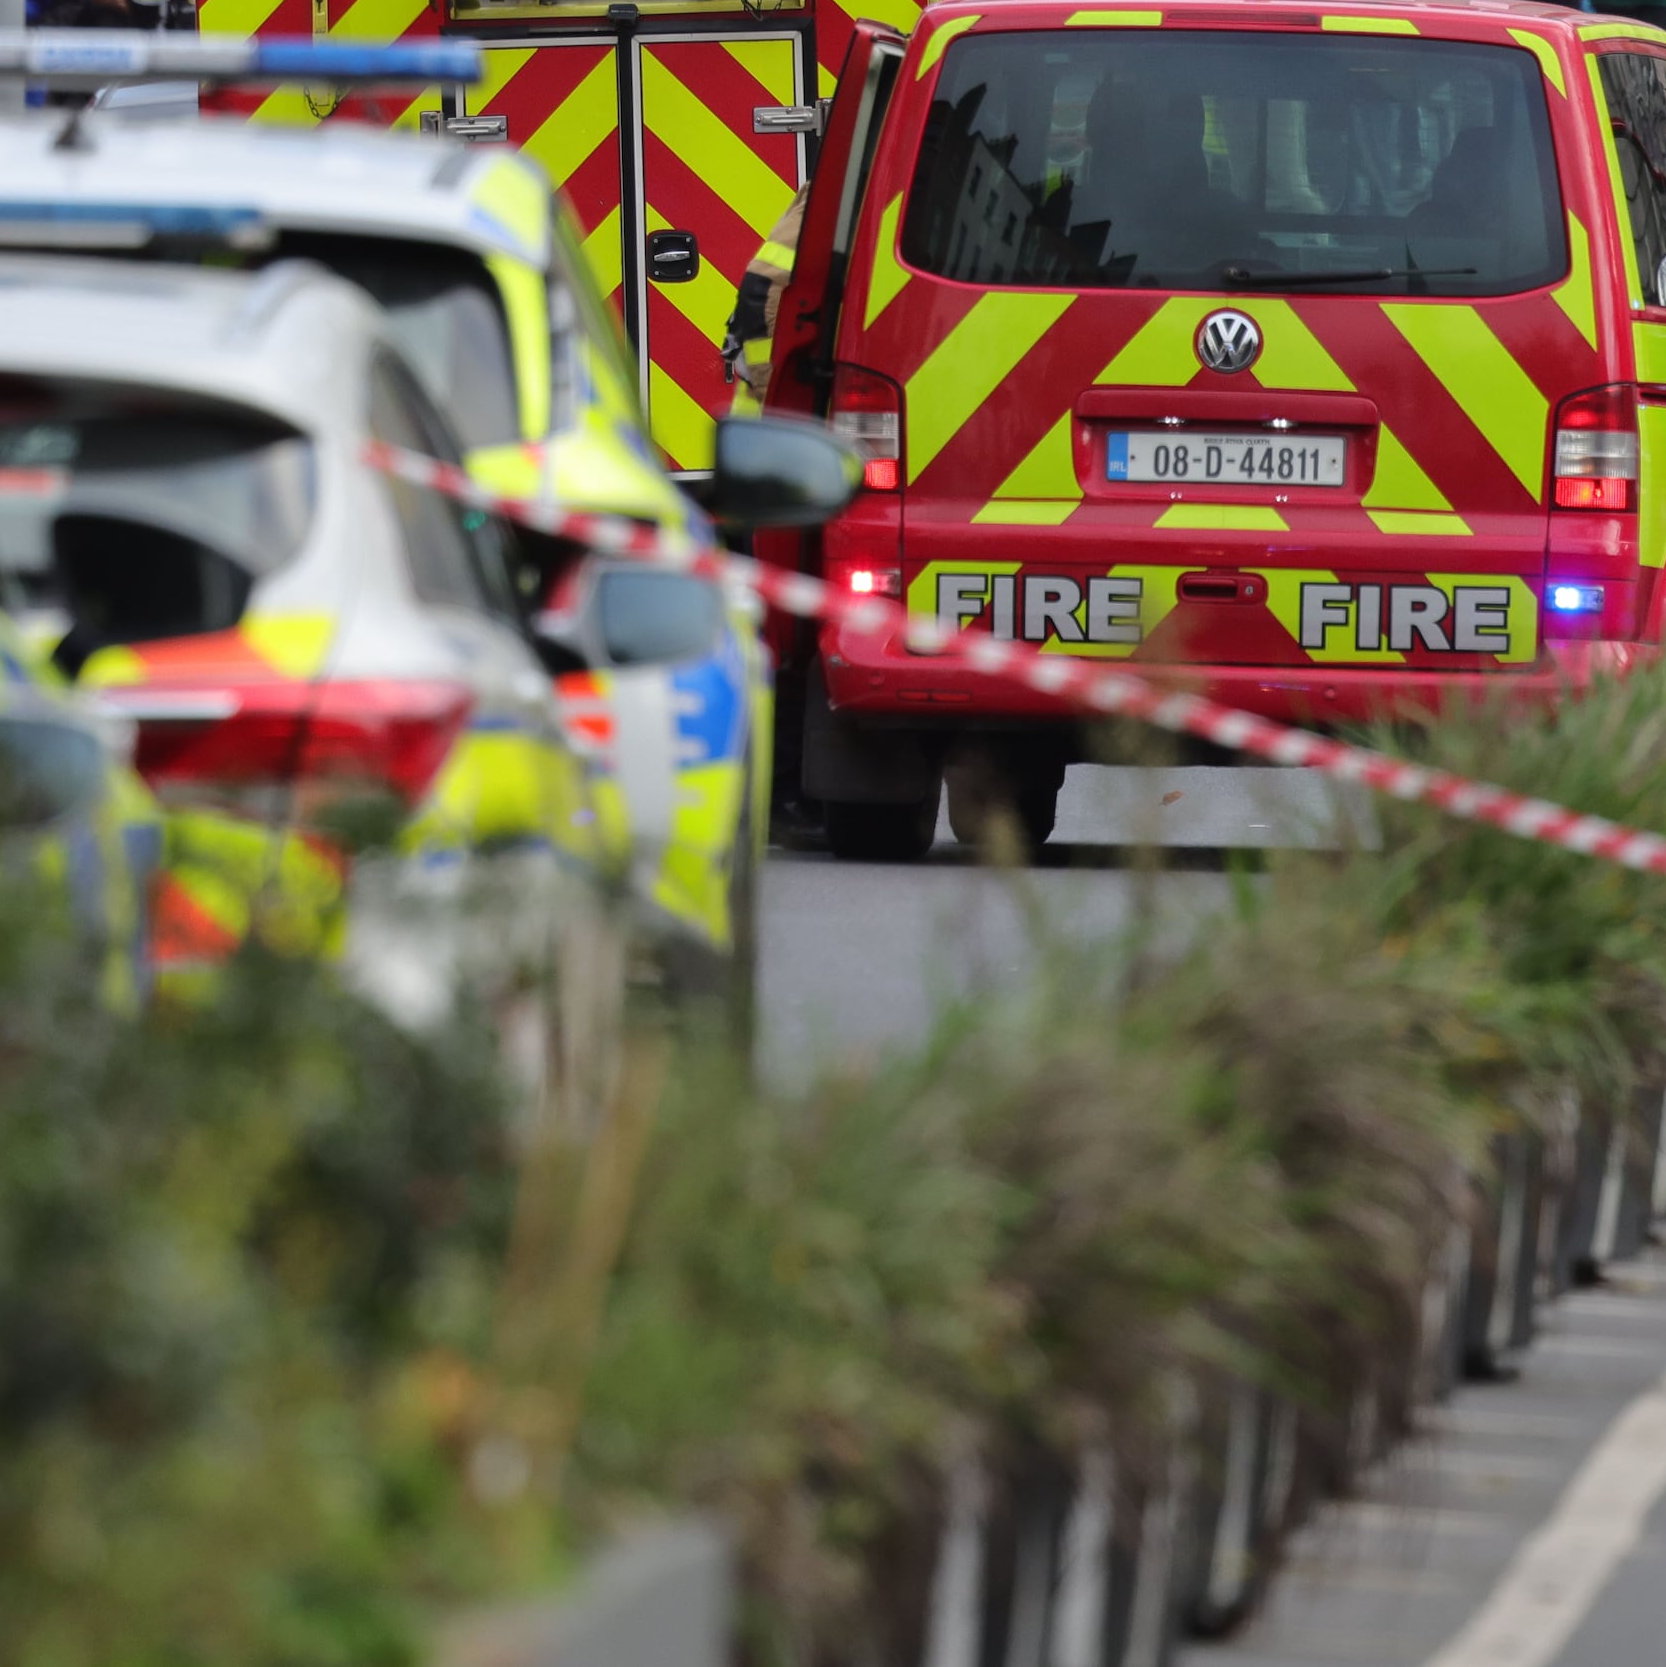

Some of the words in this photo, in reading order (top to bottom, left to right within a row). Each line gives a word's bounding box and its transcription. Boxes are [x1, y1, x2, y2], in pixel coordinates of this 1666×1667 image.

[1109, 461, 1127, 472] IRL
[1154, 444, 1320, 481] 08-D-44811
[936, 573, 1143, 643] FIRE
[1300, 581, 1511, 653] FIRE
